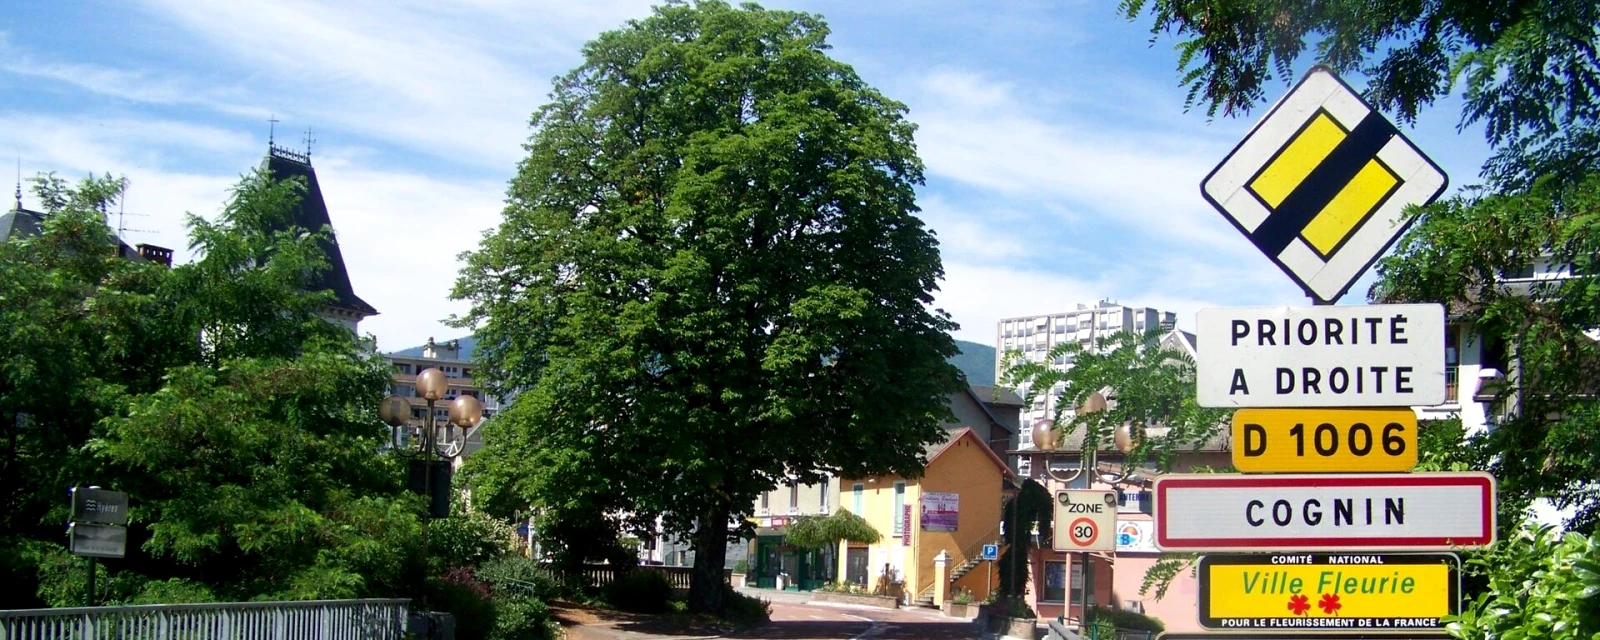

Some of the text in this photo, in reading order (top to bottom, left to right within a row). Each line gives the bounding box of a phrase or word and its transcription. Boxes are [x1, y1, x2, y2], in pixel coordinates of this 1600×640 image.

[1231, 314, 1408, 346] PRIORITÉ
[1229, 366, 1414, 395] A DROITE
[1243, 422, 1406, 457] D 1006
[1068, 503, 1102, 513] ZONE
[1245, 497, 1405, 527] COGNIN
[1074, 526, 1092, 538] 30
[1271, 555, 1384, 565] COMITÉ NATIONAL
[1243, 571, 1415, 594] Ville Fleurie
[1221, 617, 1437, 628] POUR LE FLEURISSEMENT DE LA FRANCE
